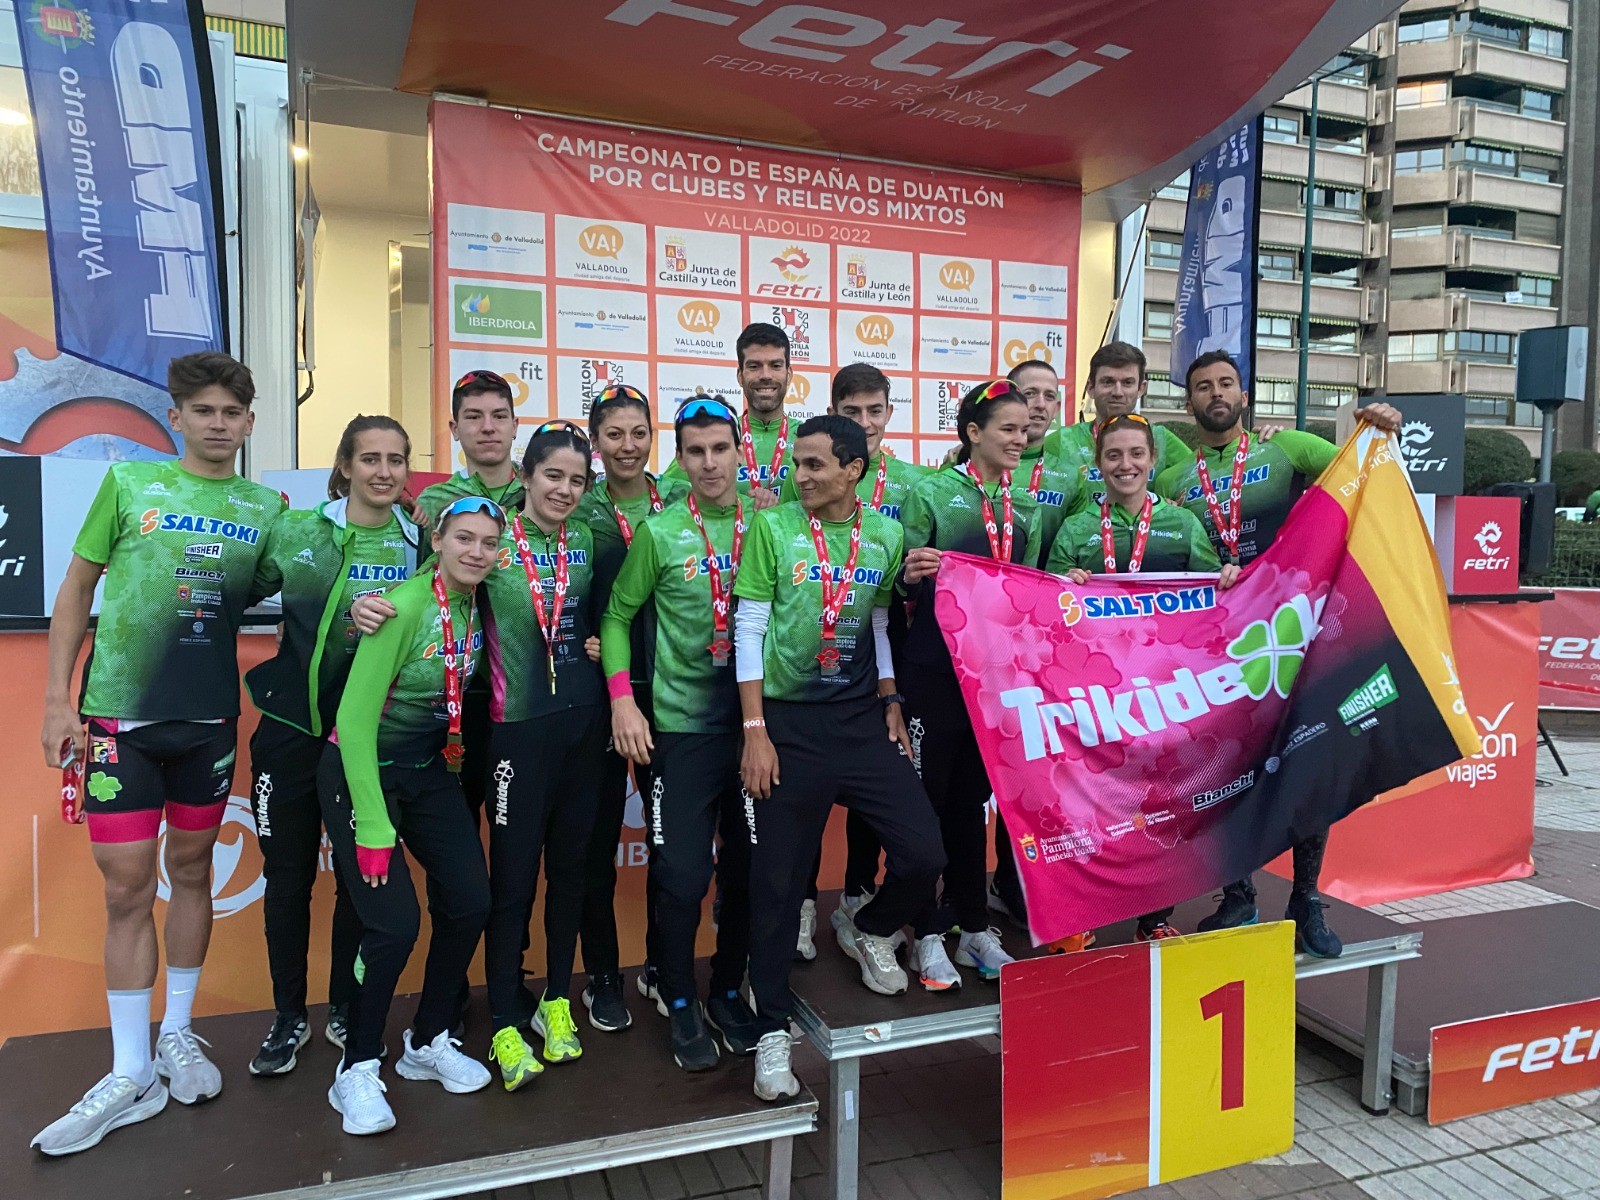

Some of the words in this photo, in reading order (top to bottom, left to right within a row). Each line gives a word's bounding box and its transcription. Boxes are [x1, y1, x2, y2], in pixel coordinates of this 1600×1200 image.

[703, 54, 890, 91] FEDERACIÓN
[891, 82, 1028, 115] ESAÑOLA
[834, 94, 877, 109] DE
[888, 96, 1001, 130] RIATLÓN
[537, 133, 722, 173] CAMPEONATO
[730, 159, 761, 180] DE
[768, 164, 860, 192] ESPAÑA
[867, 176, 897, 197] DE
[903, 181, 1005, 209] DUATLÓN
[589, 164, 643, 189] POR
[651, 172, 746, 201] CLUBES
[752, 184, 769, 203] Y
[776, 187, 880, 217] RELEVOS
[886, 202, 968, 226] MIXTOS
[704, 211, 824, 238] VALLADOLID
[829, 225, 871, 243] 2022
[583, 231, 617, 252] VA!
[576, 262, 628, 274] VALLADOLID
[689, 264, 721, 277] Junta
[723, 266, 736, 277] de
[943, 266, 970, 285] VA!
[659, 271, 698, 284] Castilla
[701, 275, 709, 287] y
[711, 276, 736, 288] León
[869, 280, 896, 292] Junta
[899, 283, 911, 292] de
[841, 288, 876, 300] Castilla
[878, 291, 886, 302] y
[887, 291, 911, 302] León
[936, 294, 978, 305] VALLADOLID
[469, 316, 537, 331] IBERDROLA
[681, 308, 714, 327] VA!
[860, 321, 888, 338] VA!
[675, 337, 724, 349] VALLADOLID
[1046, 331, 1062, 348] fit
[853, 350, 896, 360] VALLADOLID
[520, 361, 543, 381] fit
[160, 513, 260, 546] SALTOKI
[186, 545, 220, 556] FINISHER
[347, 564, 408, 581] ALTOK
[1083, 584, 1216, 620] SALTOKI
[1340, 673, 1394, 720] FINISHER
[1446, 763, 1497, 788] viajes
[1193, 770, 1255, 807] Bianchi
[1041, 836, 1093, 855] Pamplona
[1200, 980, 1245, 1111] 1
